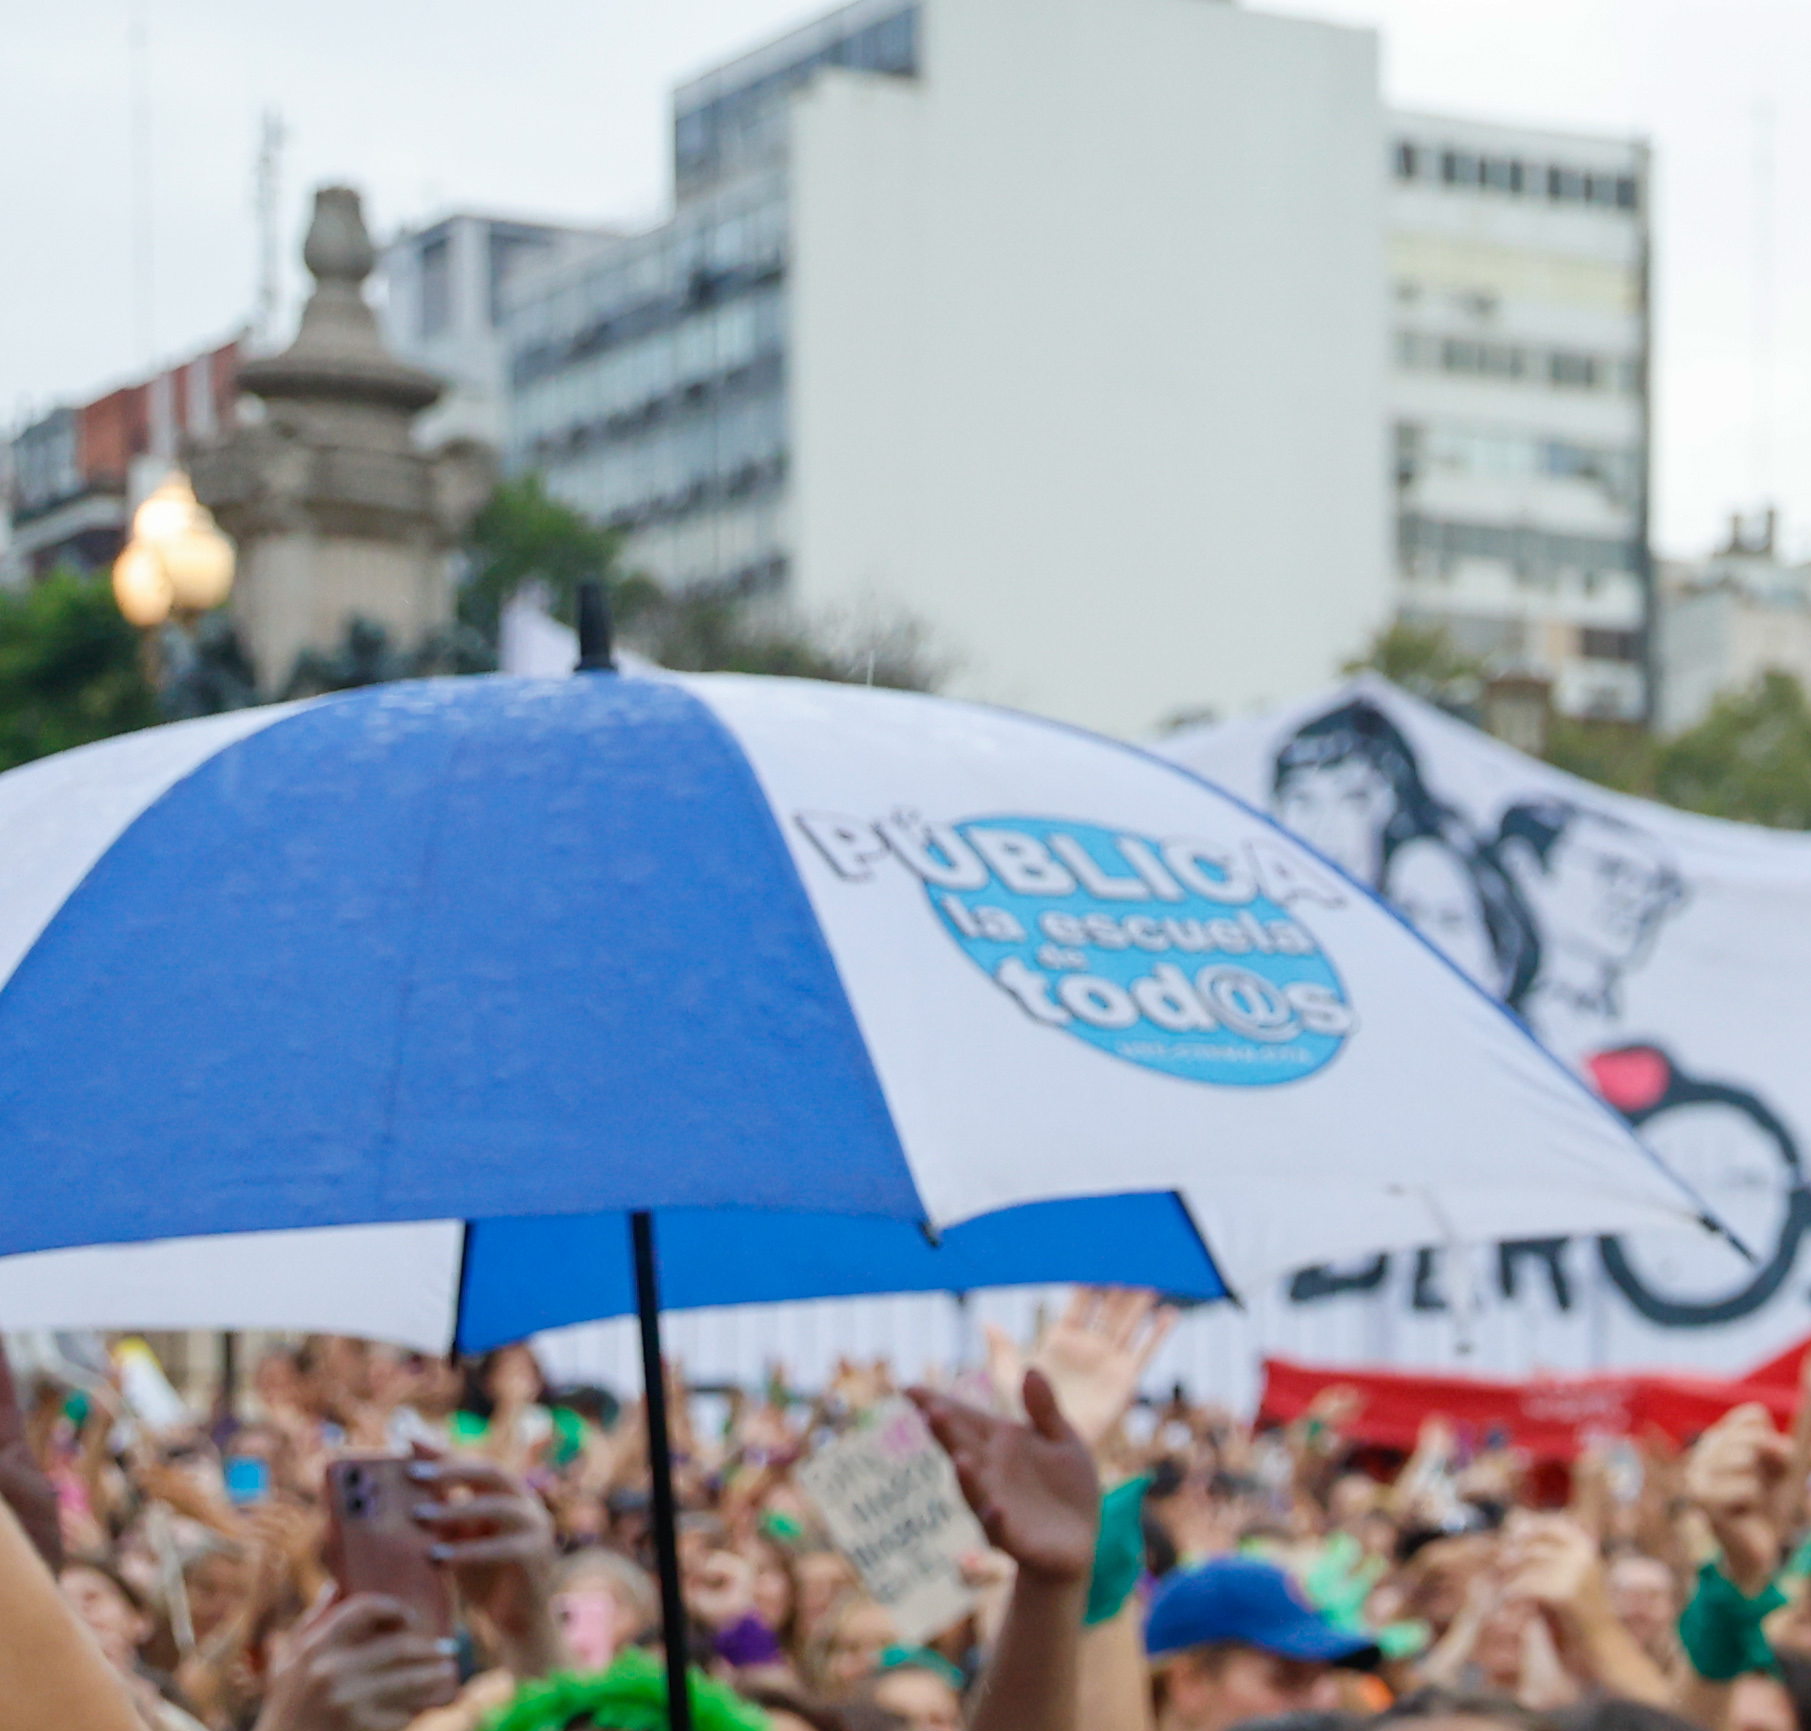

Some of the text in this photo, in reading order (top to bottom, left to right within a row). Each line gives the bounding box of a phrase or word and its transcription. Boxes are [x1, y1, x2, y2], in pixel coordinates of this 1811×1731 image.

[794, 808, 1346, 911] PÚBLICA
[941, 896, 1320, 954] la escuela
[993, 955, 1358, 1044] tod@s
